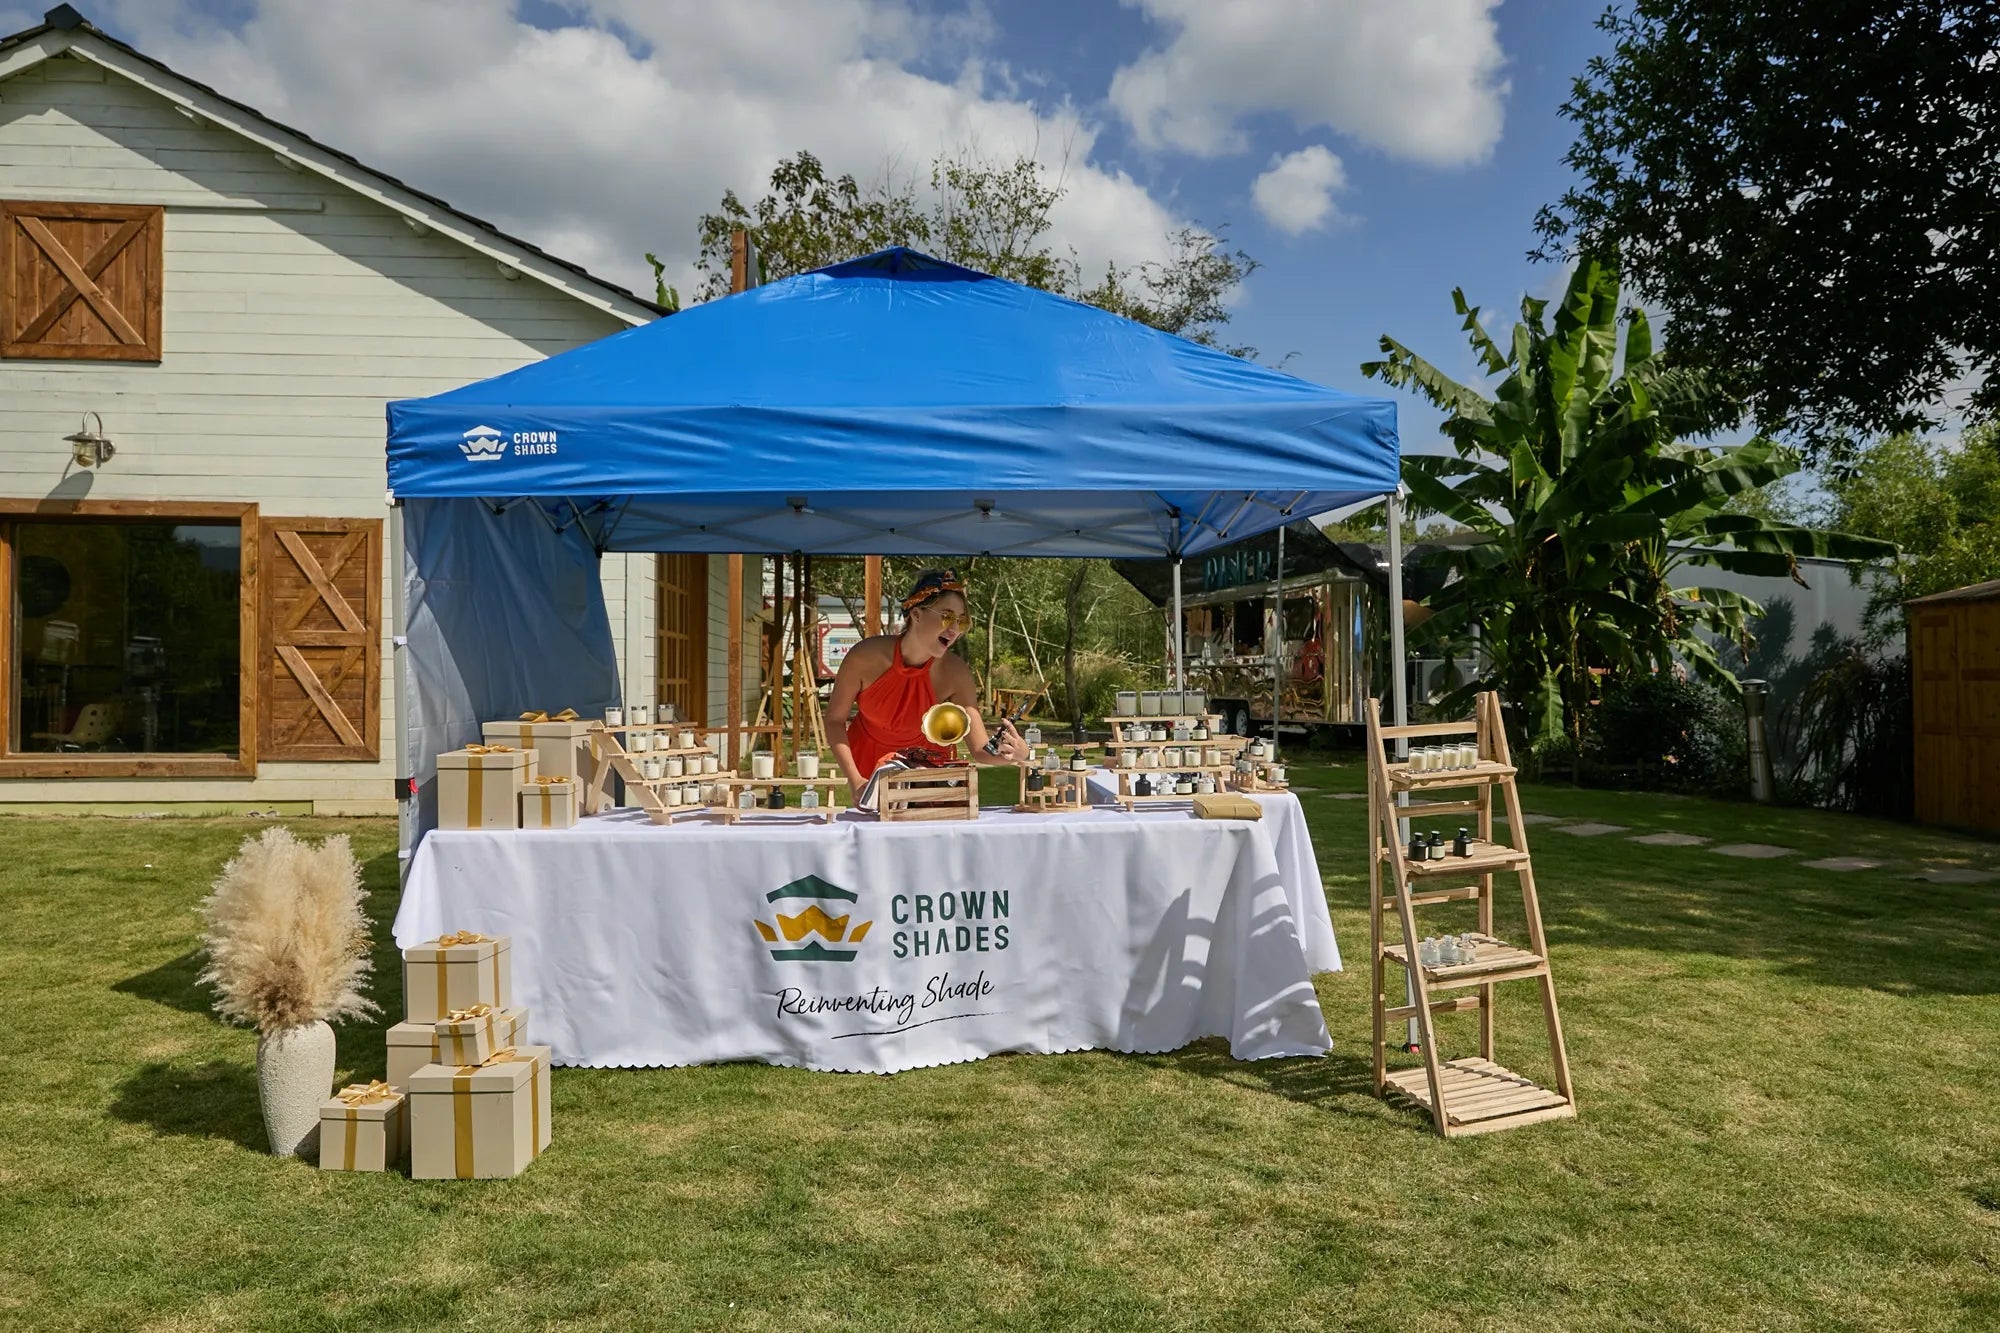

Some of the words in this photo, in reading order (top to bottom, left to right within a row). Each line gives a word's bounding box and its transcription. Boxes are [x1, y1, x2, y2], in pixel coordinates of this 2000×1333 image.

[513, 431, 557, 443] CROWN
[514, 444, 557, 455] SHADES
[891, 890, 1009, 925] CROWN
[893, 925, 1009, 958] SHADES
[775, 985, 915, 1025] Reinventing
[921, 970, 994, 1009] Shade
